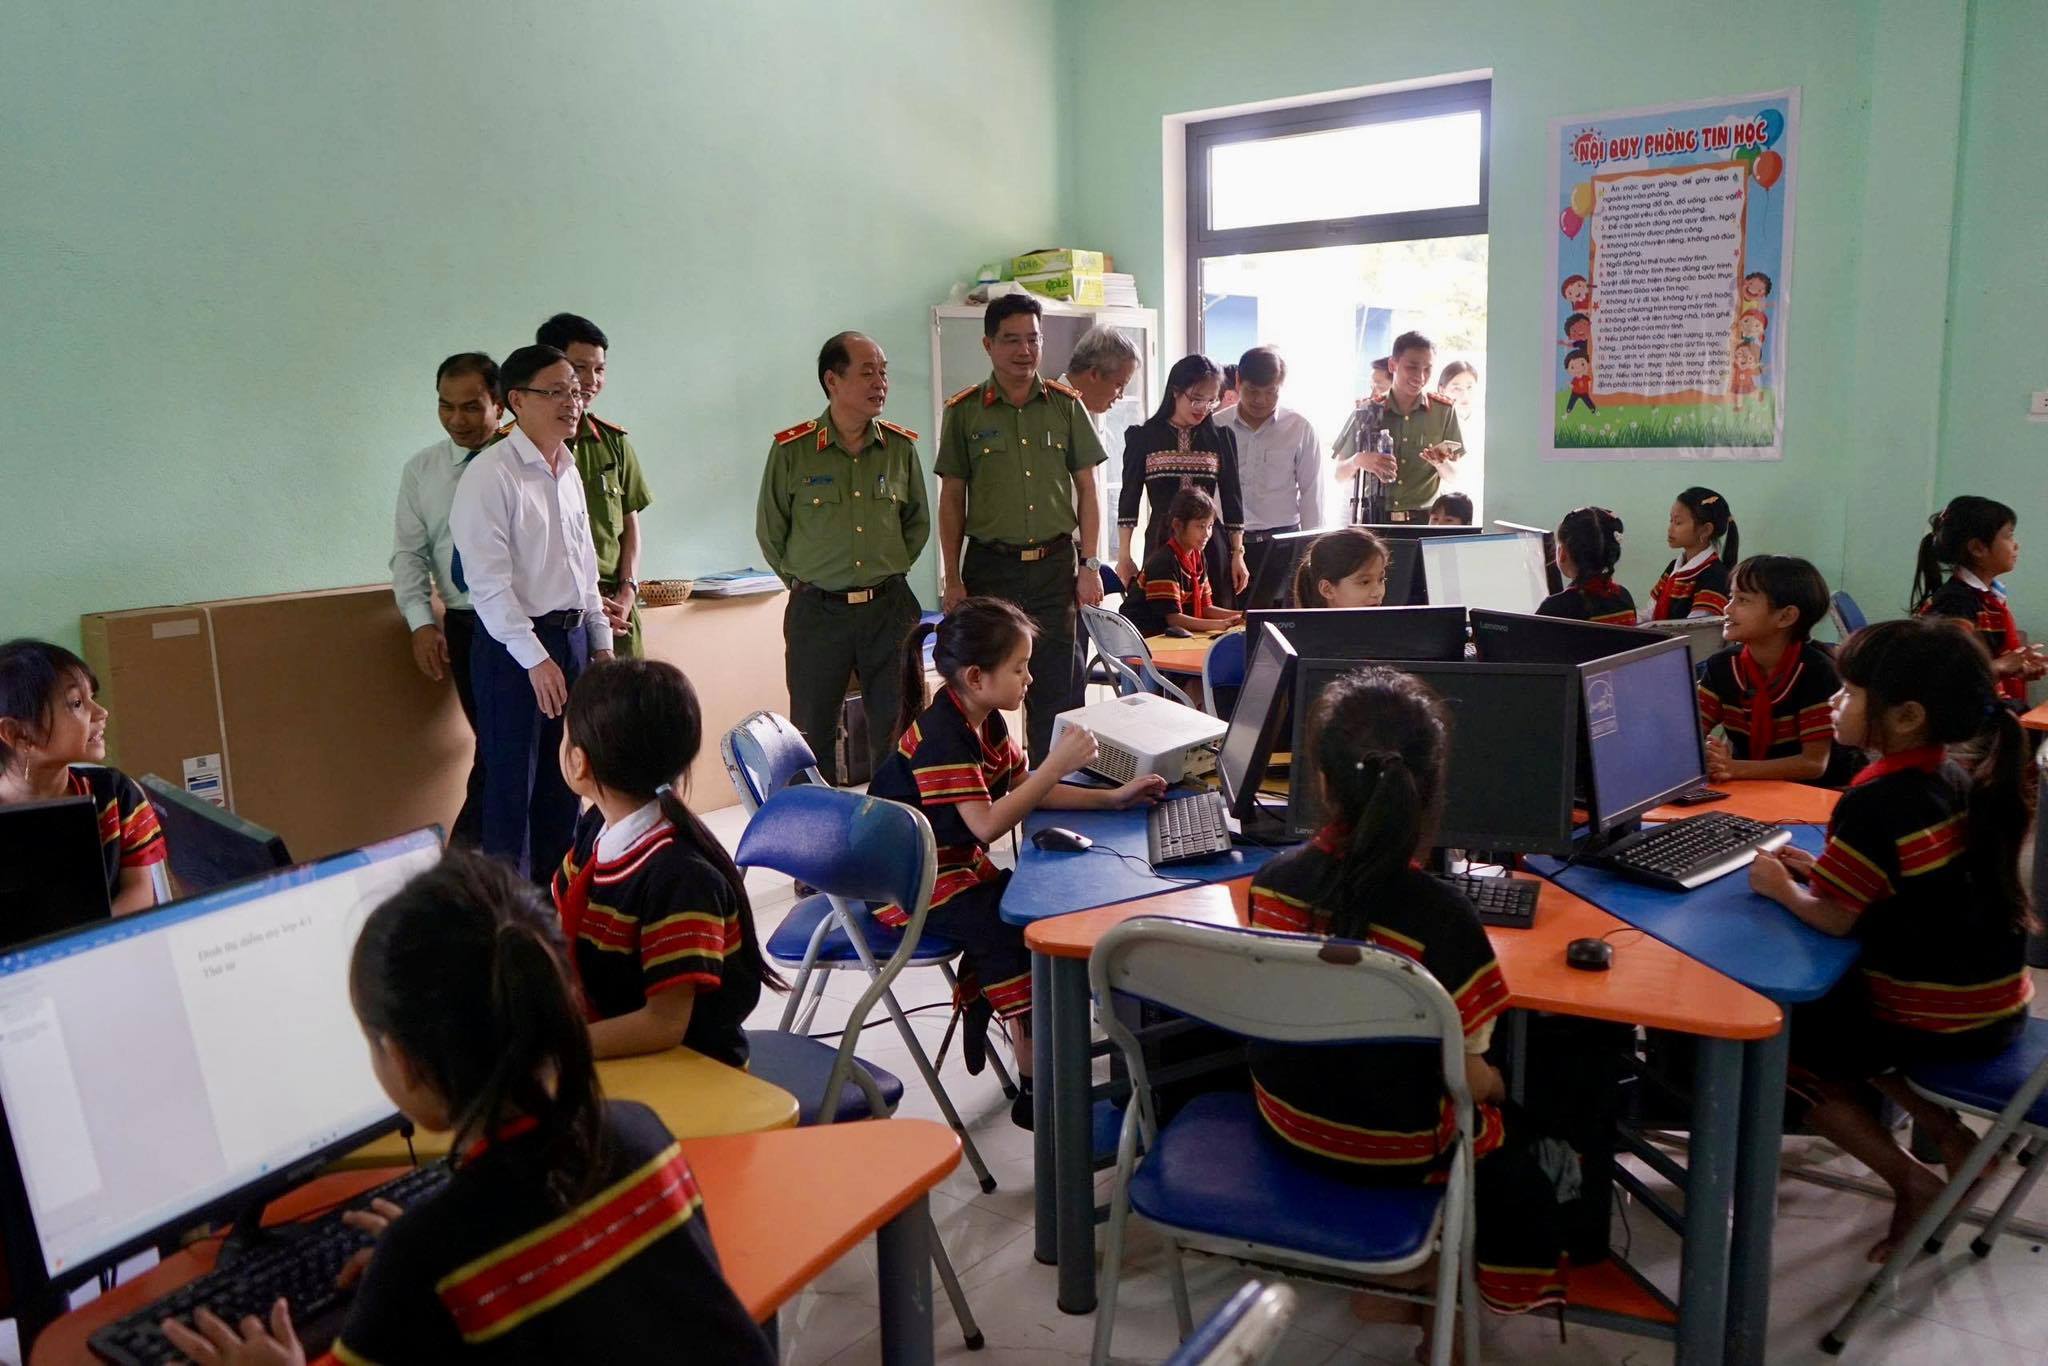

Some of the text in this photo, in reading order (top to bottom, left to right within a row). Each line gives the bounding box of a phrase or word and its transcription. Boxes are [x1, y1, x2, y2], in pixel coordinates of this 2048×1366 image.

[1579, 120, 1767, 166] NỘI QUY PHÒNG TIN HỌC
[1479, 620, 1509, 632] Lenovo
